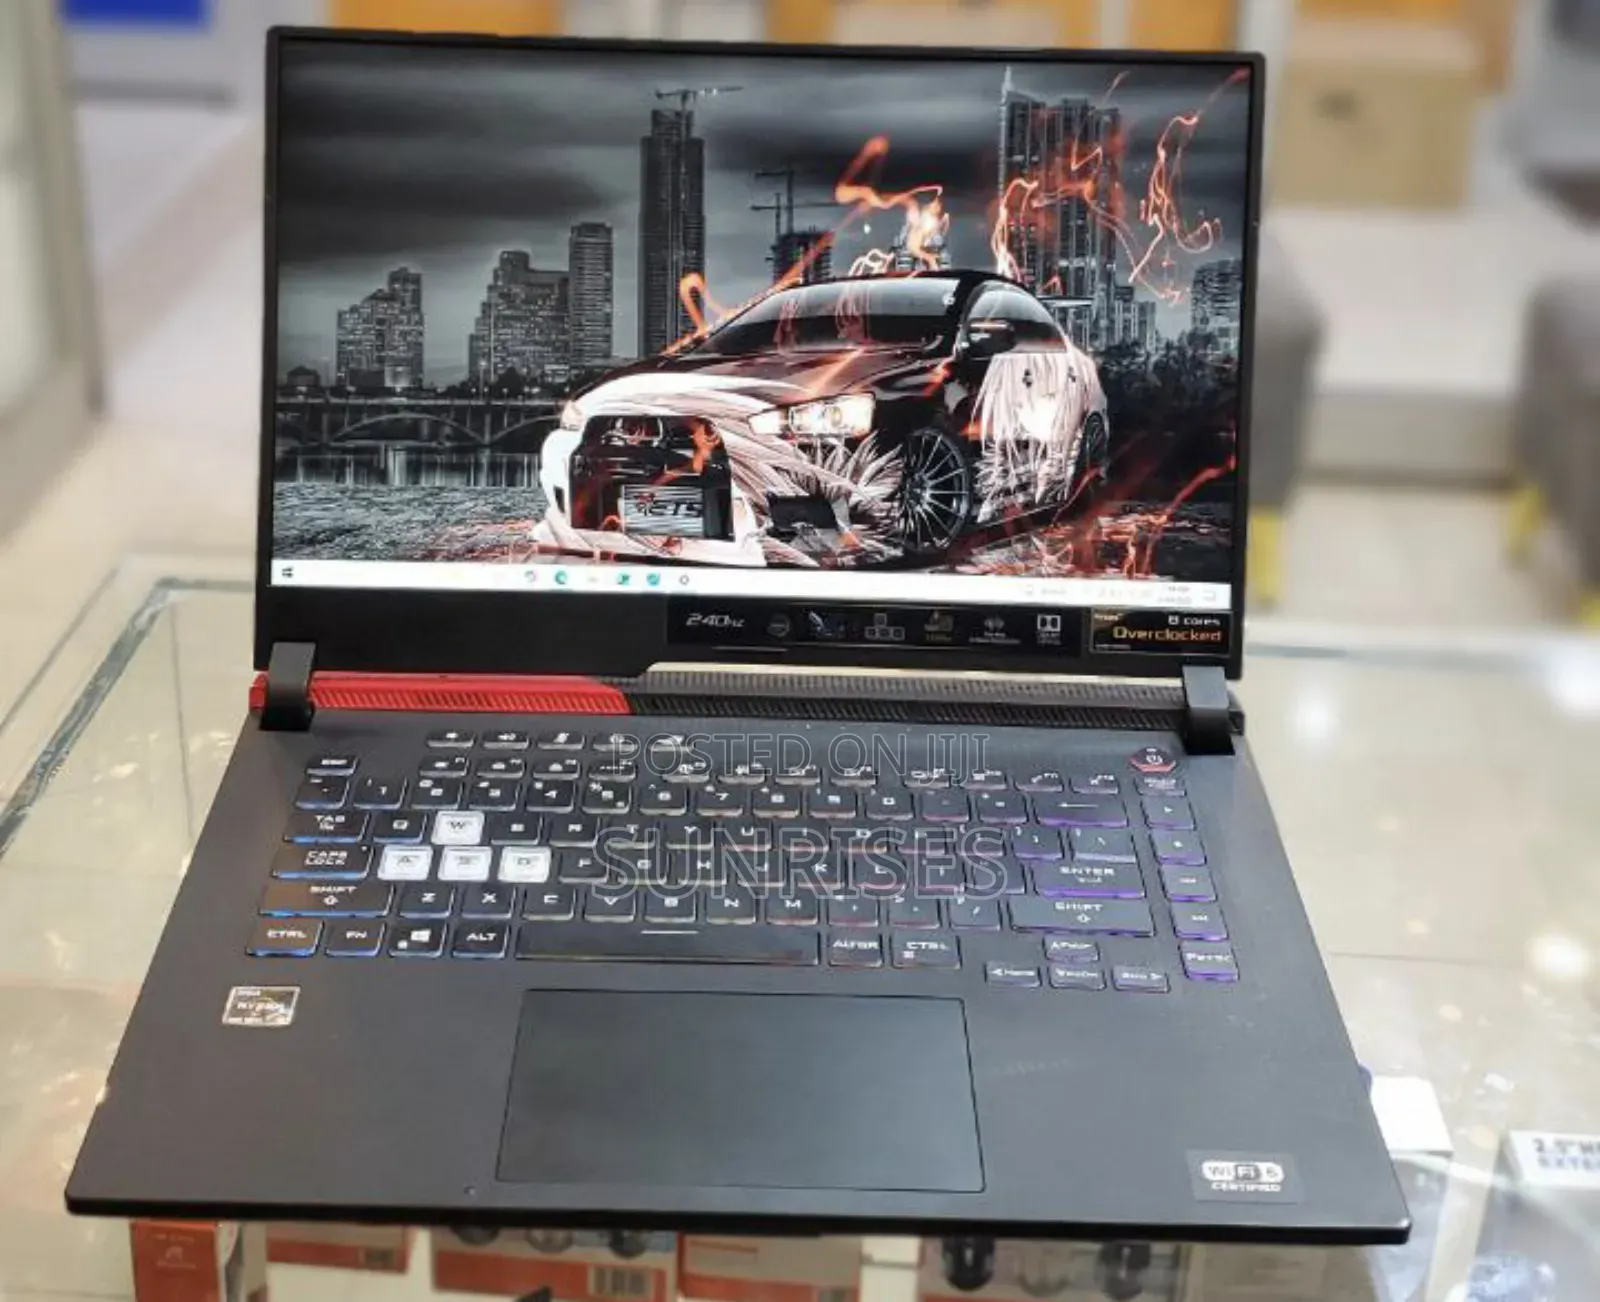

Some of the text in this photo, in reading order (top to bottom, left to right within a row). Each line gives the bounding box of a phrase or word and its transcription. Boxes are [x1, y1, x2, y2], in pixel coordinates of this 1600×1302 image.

[1112, 625, 1222, 641] Overclocked
[315, 815, 346, 823] TAB
[304, 857, 346, 865] LOCK
[1060, 867, 1115, 876] ENTER
[309, 885, 357, 894] SHIFT
[1055, 902, 1103, 911] SHIFT
[266, 929, 307, 938] CTRL
[346, 931, 367, 939] FN
[466, 932, 497, 941] ALT
[906, 941, 948, 950] CTRL
